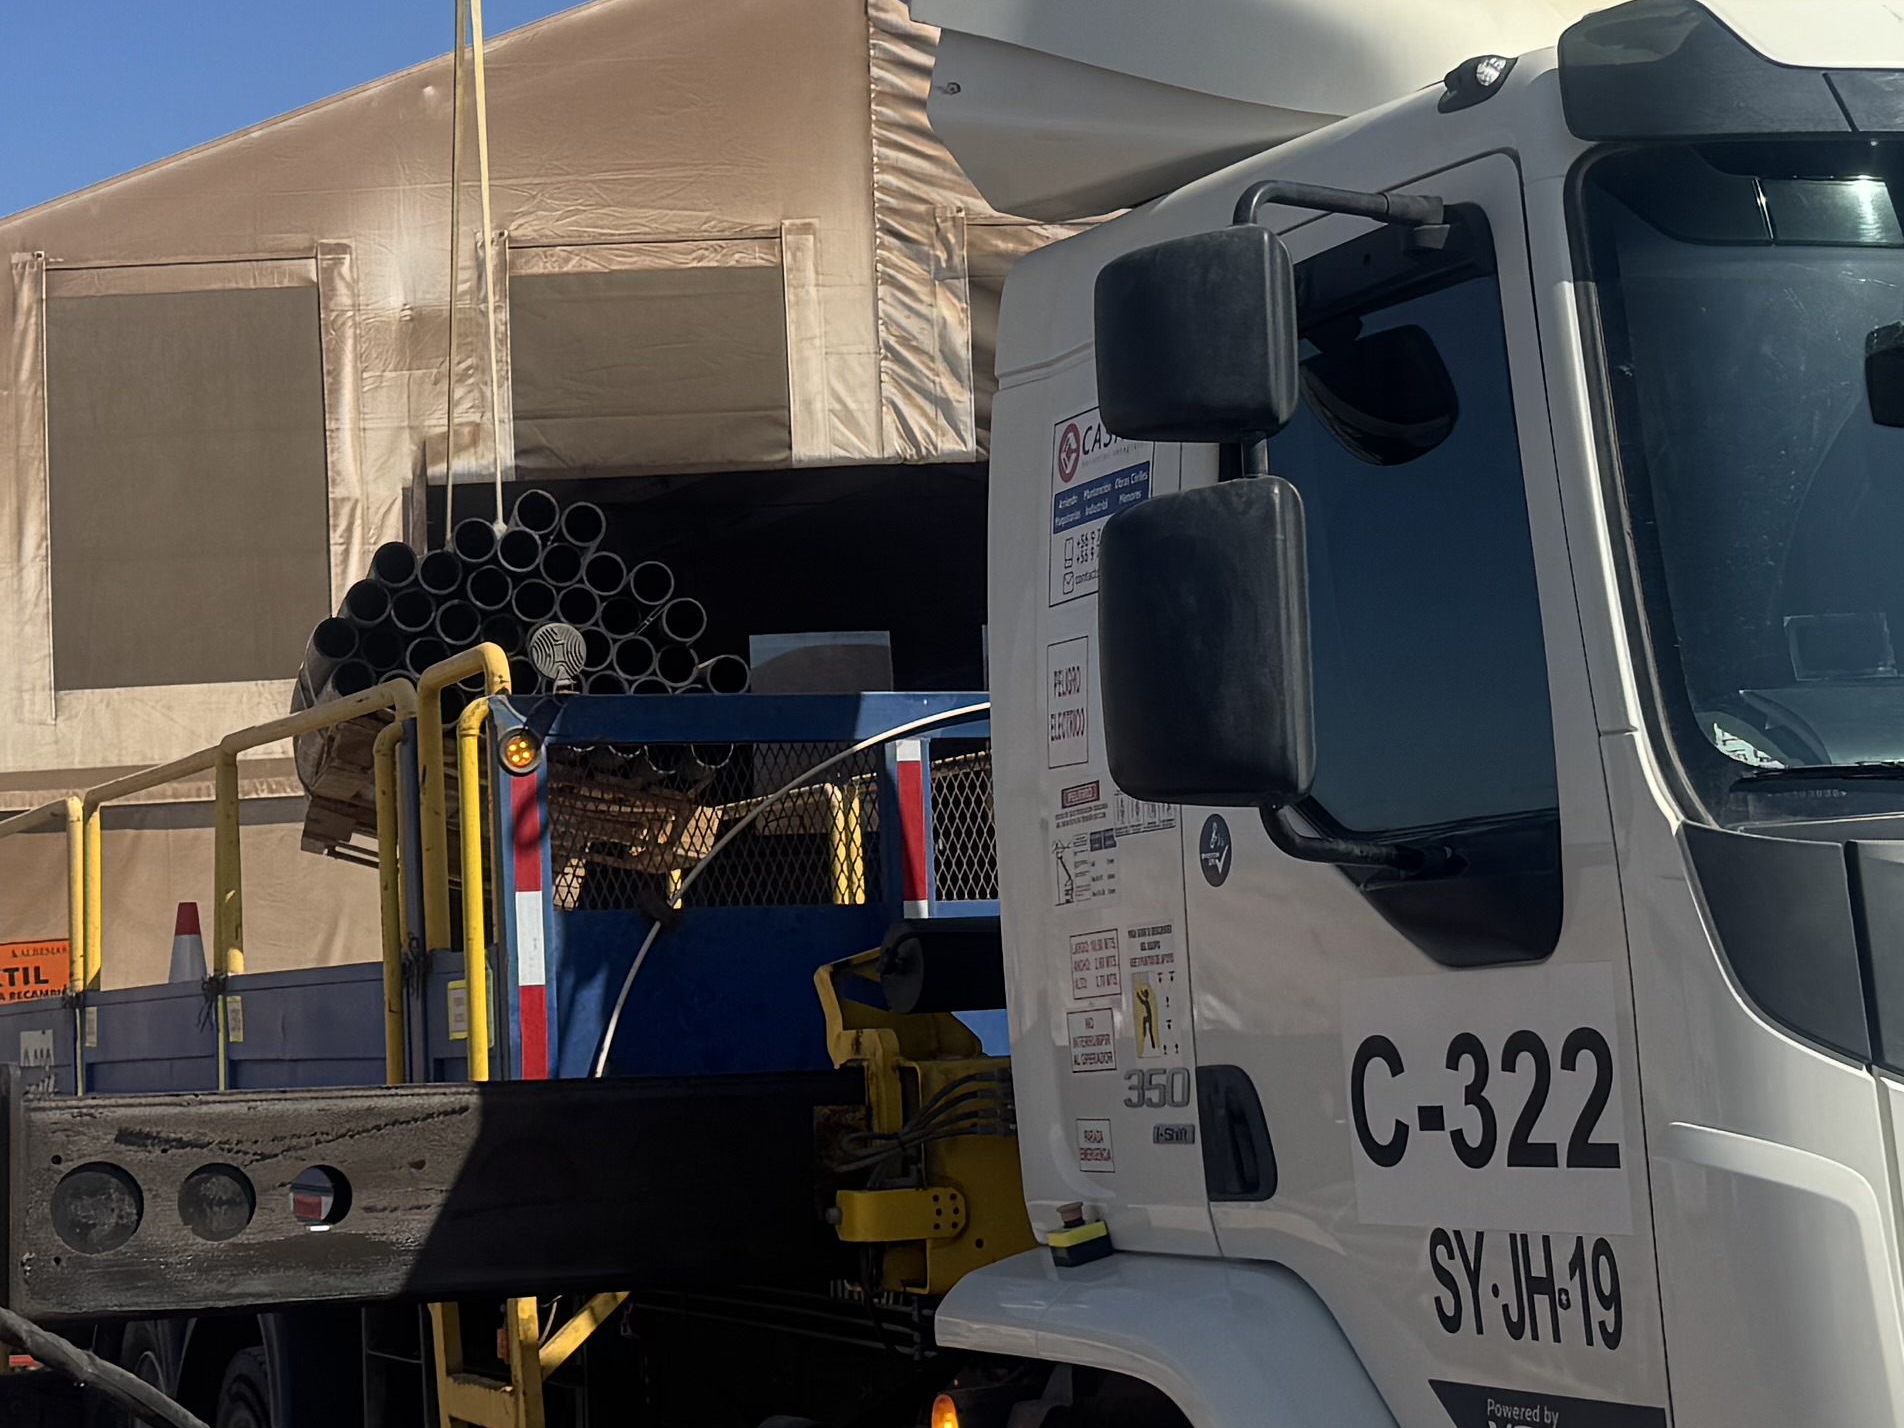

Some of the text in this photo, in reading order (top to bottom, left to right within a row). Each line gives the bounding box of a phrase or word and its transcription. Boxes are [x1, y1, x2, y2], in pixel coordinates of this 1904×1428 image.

[1123, 1067, 1191, 1108] 350
[1351, 1027, 1621, 1170] C-322
[1487, 1398, 1559, 1428] Powered by
